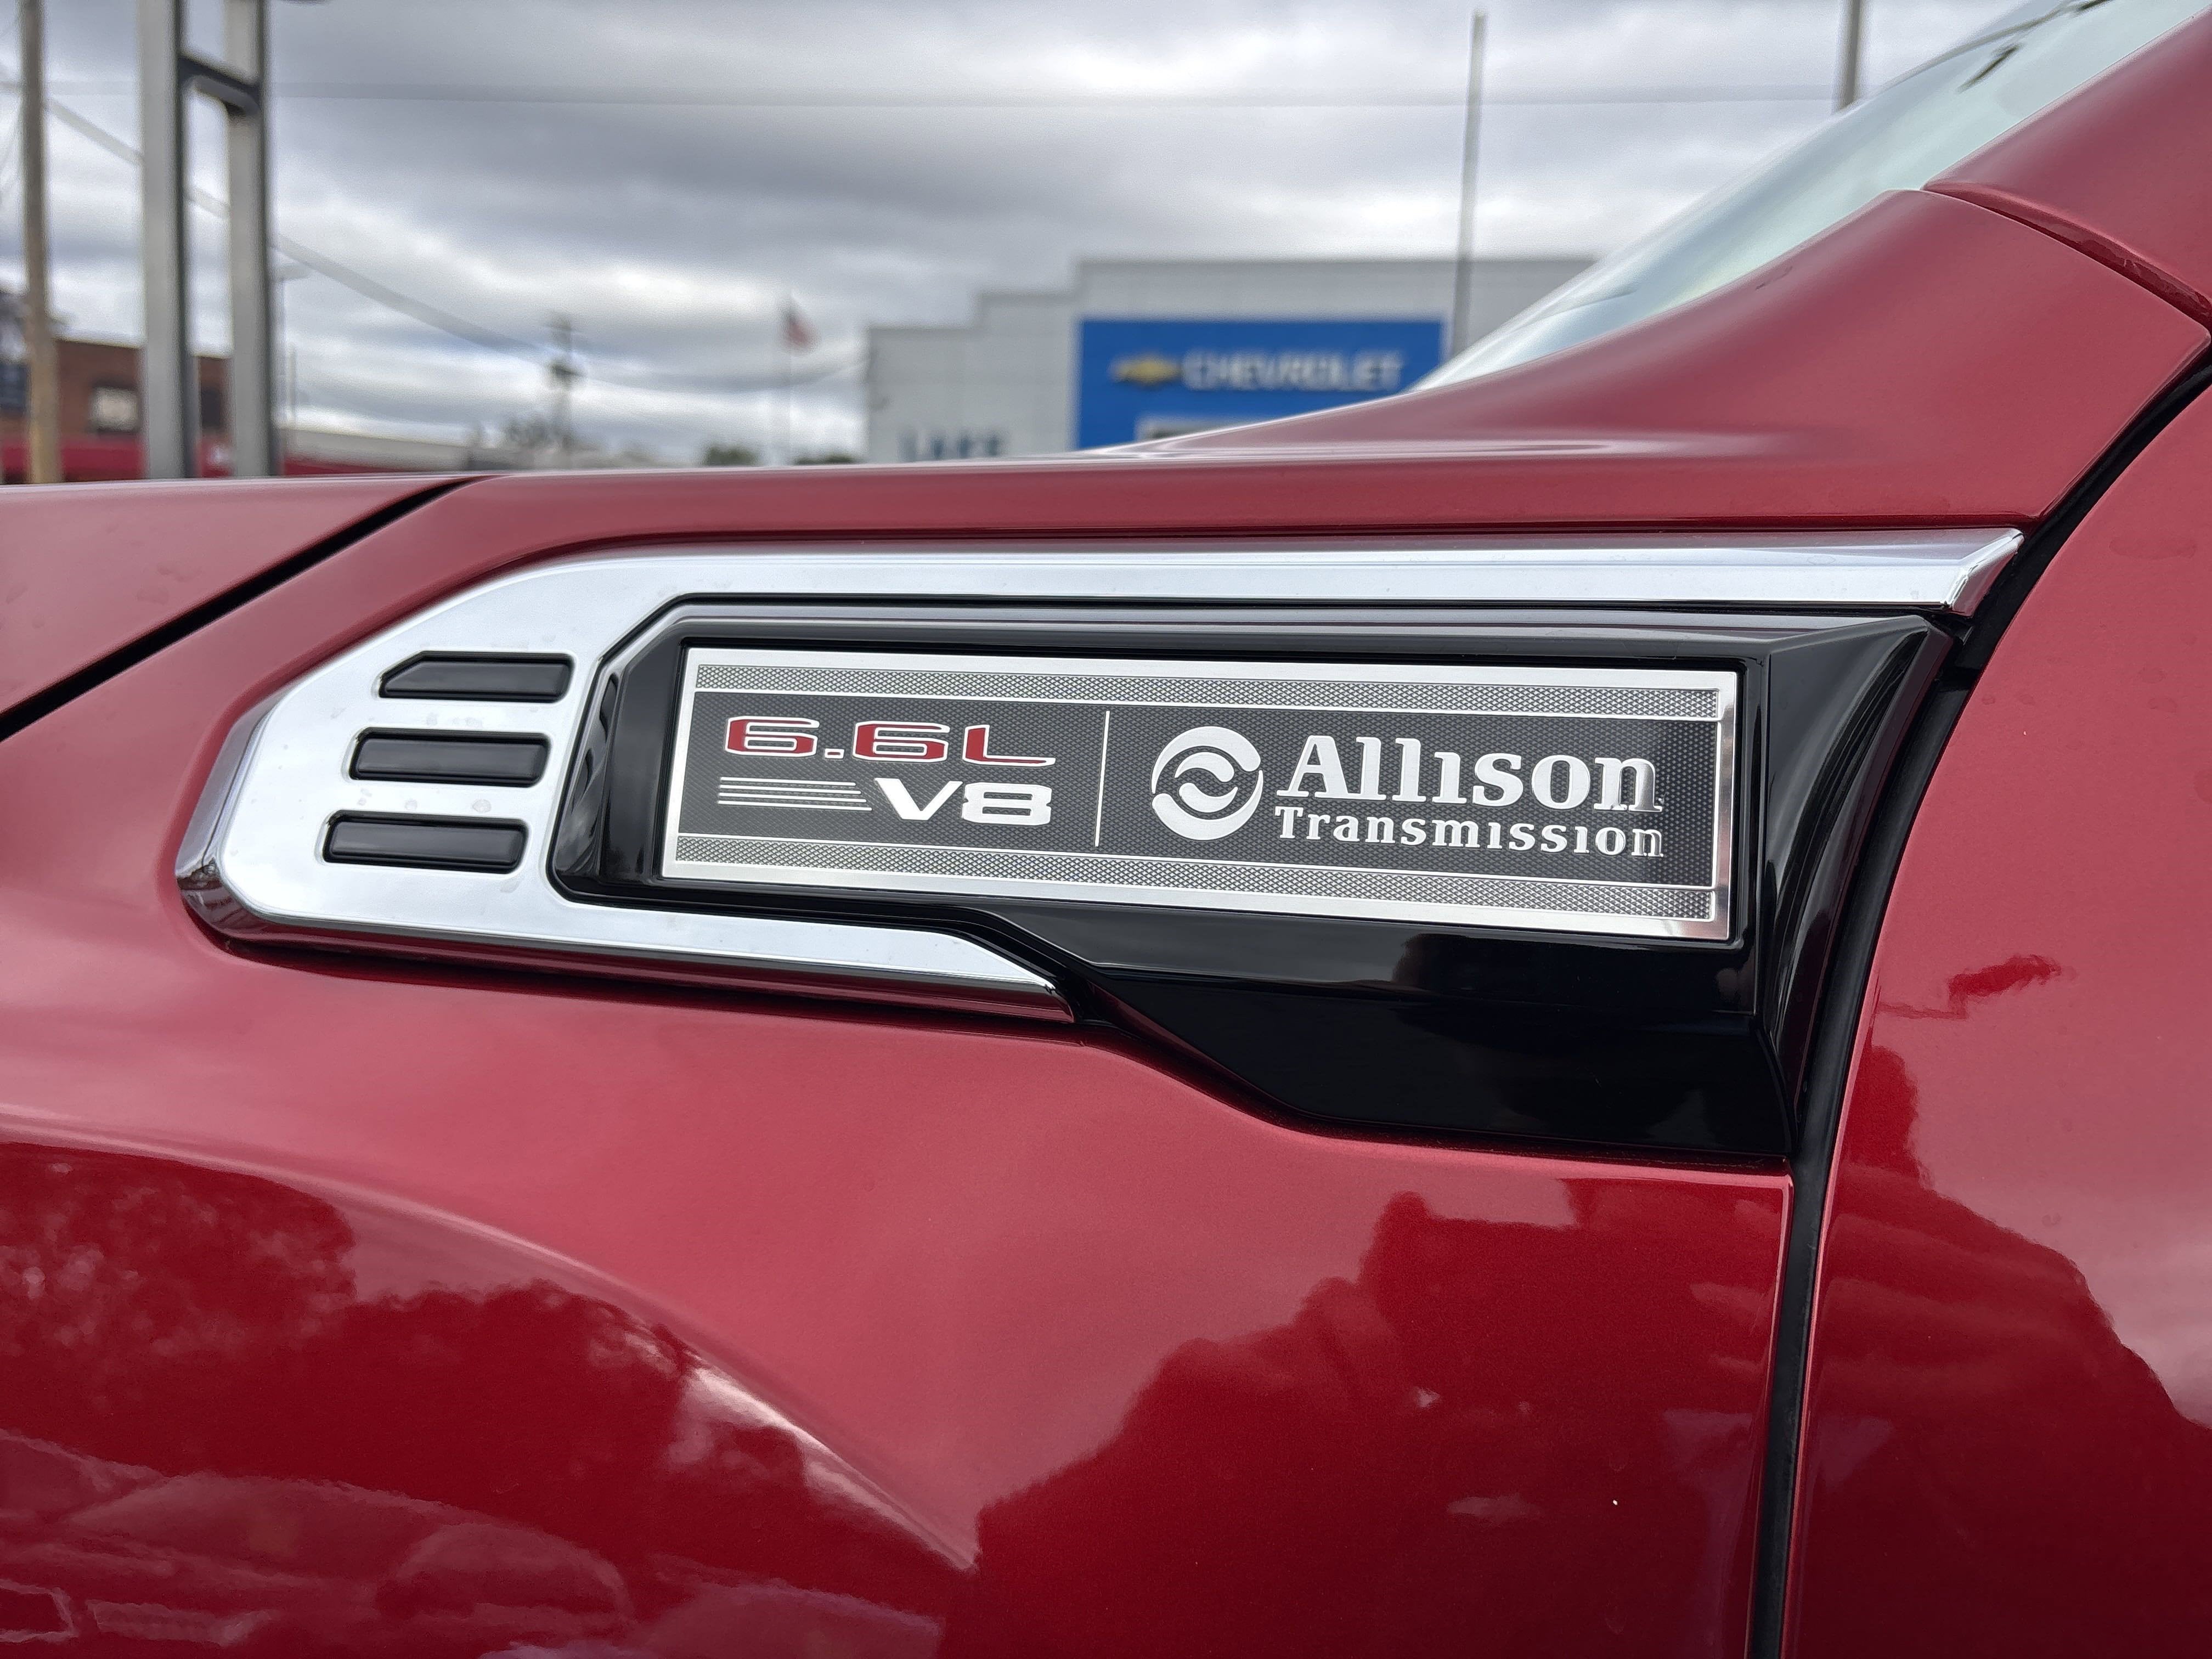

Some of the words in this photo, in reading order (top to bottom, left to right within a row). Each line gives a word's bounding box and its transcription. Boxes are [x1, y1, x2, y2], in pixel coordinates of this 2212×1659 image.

[1183, 350, 1403, 390] CHEVROLET
[726, 715, 1057, 767] 6.6L
[1276, 735, 1663, 812] Allison
[874, 778, 1053, 826] V8
[1274, 806, 1664, 857] Transmission
